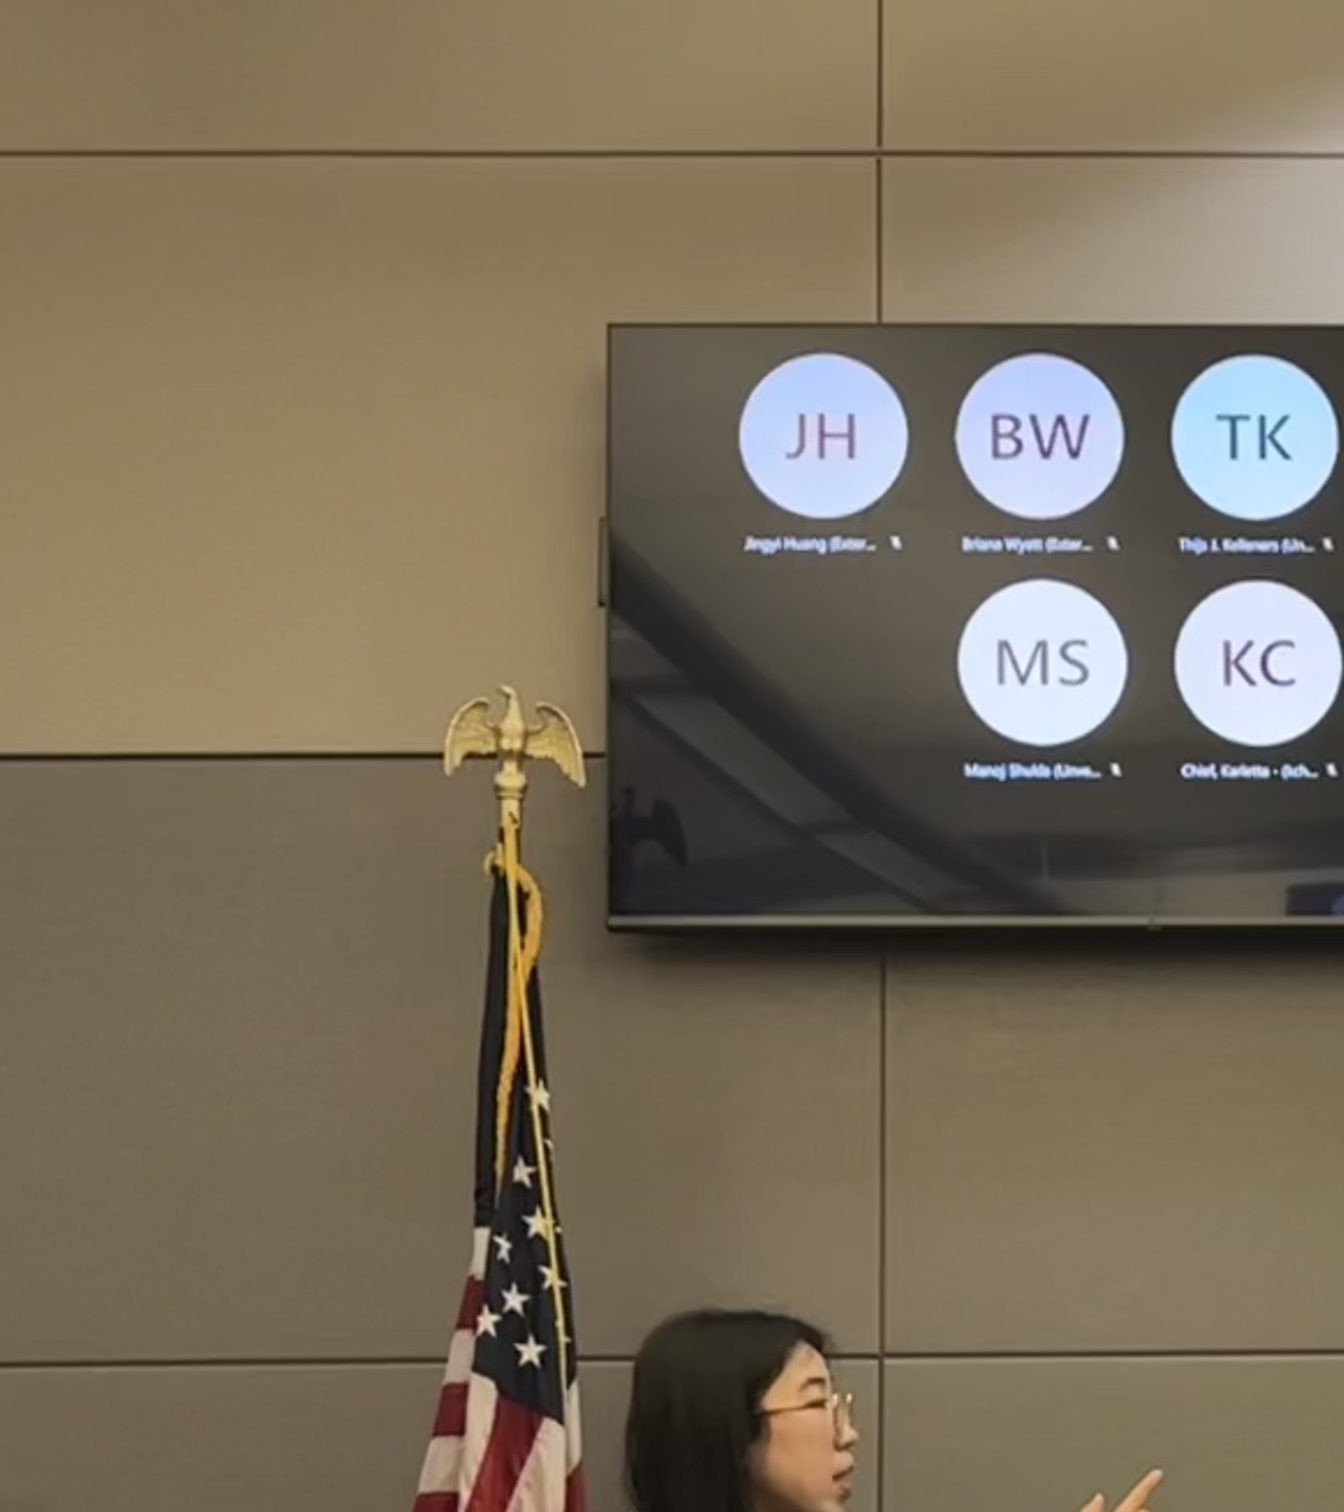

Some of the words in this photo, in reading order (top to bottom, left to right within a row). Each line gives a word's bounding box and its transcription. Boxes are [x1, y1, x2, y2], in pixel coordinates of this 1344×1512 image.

[785, 413, 858, 461] JH
[989, 413, 1090, 461] BW
[1216, 413, 1293, 461] TK
[783, 536, 827, 555] Huang
[995, 637, 1090, 688] MS
[1221, 638, 1296, 688] KC
